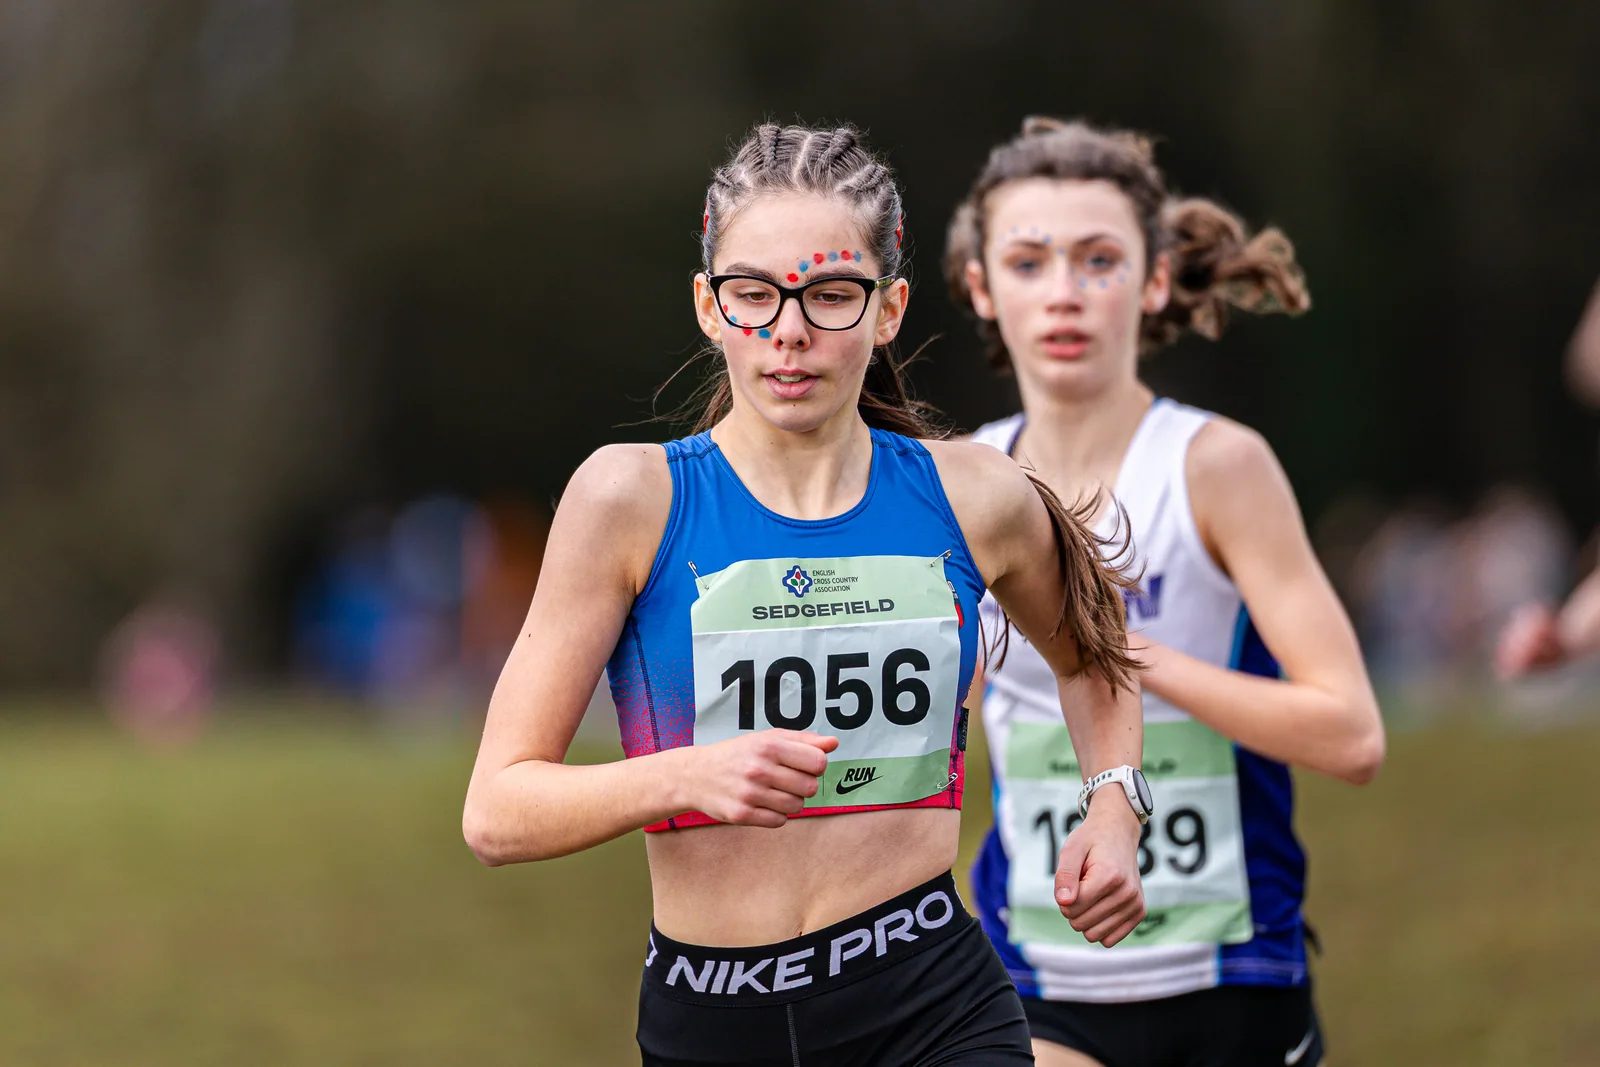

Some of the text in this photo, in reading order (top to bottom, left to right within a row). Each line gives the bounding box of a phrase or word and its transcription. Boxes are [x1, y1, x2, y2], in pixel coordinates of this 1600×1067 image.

[812, 569, 836, 577] ENGLISH
[831, 576, 859, 585] COUNTRY
[814, 585, 851, 593] ASSOCIATION
[752, 598, 895, 620] SEDGEFIELD
[721, 648, 931, 731] 1056
[844, 767, 876, 782] RUN
[665, 946, 814, 995] NIKE
[829, 890, 954, 977] PRO
